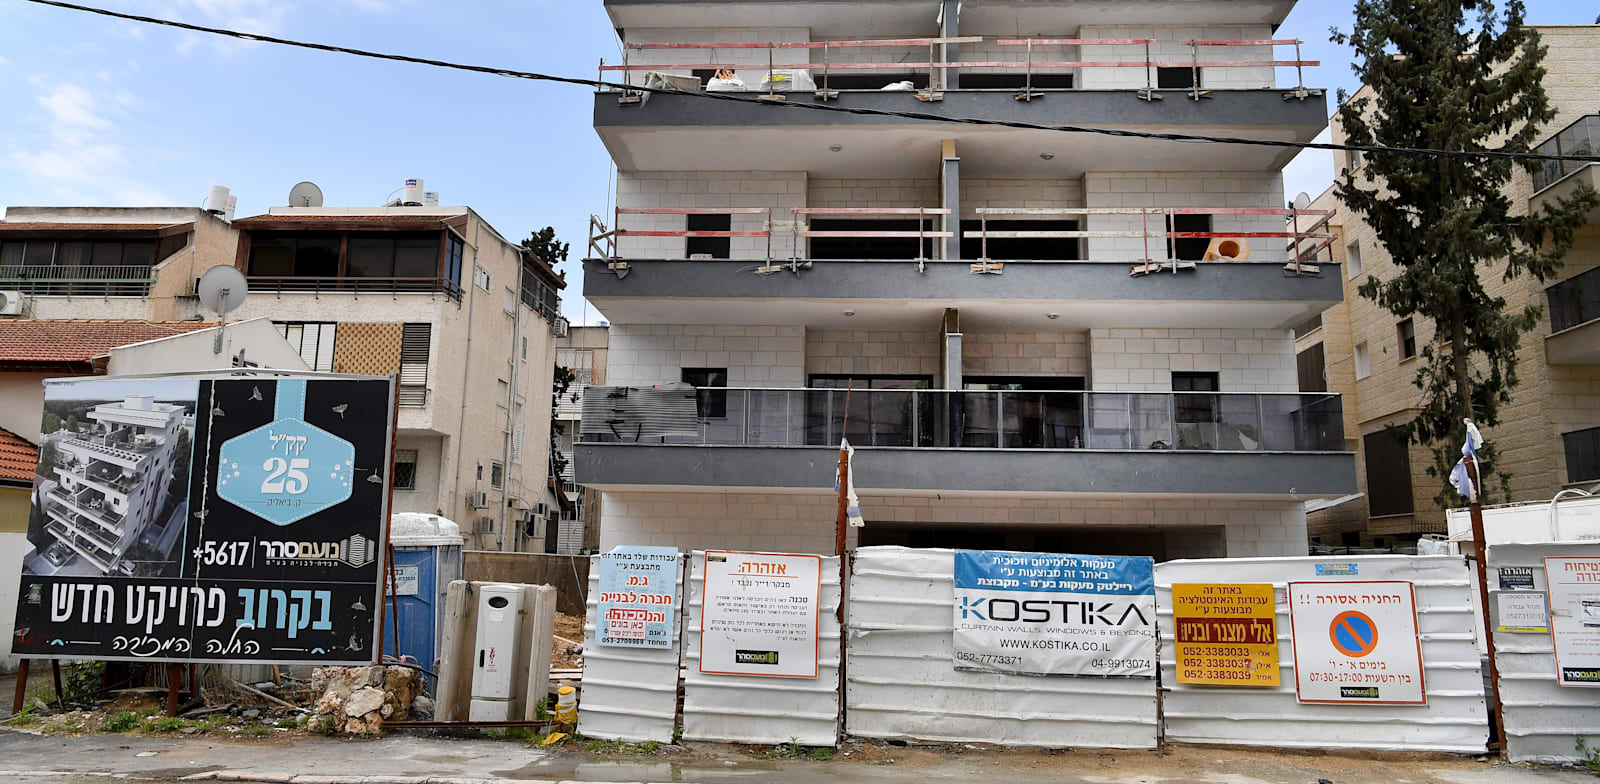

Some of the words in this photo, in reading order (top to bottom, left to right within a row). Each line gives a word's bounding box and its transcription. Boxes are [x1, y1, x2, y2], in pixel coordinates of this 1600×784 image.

[269, 429, 307, 456] קק"ל
[261, 457, 309, 494] 25
[266, 498, 292, 507] ביאליק
[650, 554, 676, 562] עבודות
[993, 556, 1028, 566] וזכוכית
[1031, 557, 1078, 568] אלומיניום
[630, 563, 661, 571] מתבצעת
[738, 562, 787, 574] אזהרה:
[1081, 559, 1115, 569] מעקות
[1565, 562, 1600, 572] טיחות
[1018, 568, 1061, 578] מבוצעות
[1064, 570, 1076, 579] זה
[1081, 571, 1109, 580] באתר
[977, 577, 1020, 587] מקבוצת
[1059, 580, 1094, 590] מעקות
[601, 591, 637, 603] לבנייה
[640, 594, 672, 605] חברה
[1179, 595, 1233, 604] האינסטלציה
[1237, 596, 1268, 605] עבודות
[1316, 595, 1358, 604] אסורה
[1361, 595, 1401, 604] החניה
[51, 583, 115, 623] חדש
[126, 585, 226, 634] פרויקט
[236, 588, 332, 638] בקרוב
[959, 596, 1150, 626] KOSTIKA
[1213, 606, 1252, 614] מבוצעות
[961, 623, 1004, 632] CURTAIN
[1047, 627, 1097, 636] WINDOWS
[1109, 629, 1151, 637] BEYOND
[1250, 618, 1272, 642] אלי
[205, 622, 260, 655] החלה
[1000, 639, 1111, 651] WWW.KOSTIKA.CO.IL
[1183, 647, 1250, 656] 052-3383033
[956, 652, 1023, 665] 052-7773371
[1091, 659, 1150, 669] 04-9913074
[1360, 661, 1387, 670] בימים
[1184, 669, 1251, 680] 052-3383039
[1309, 672, 1362, 682] 07:30-17:00
[1365, 674, 1396, 683] השעות
[1398, 674, 1411, 685] בין
